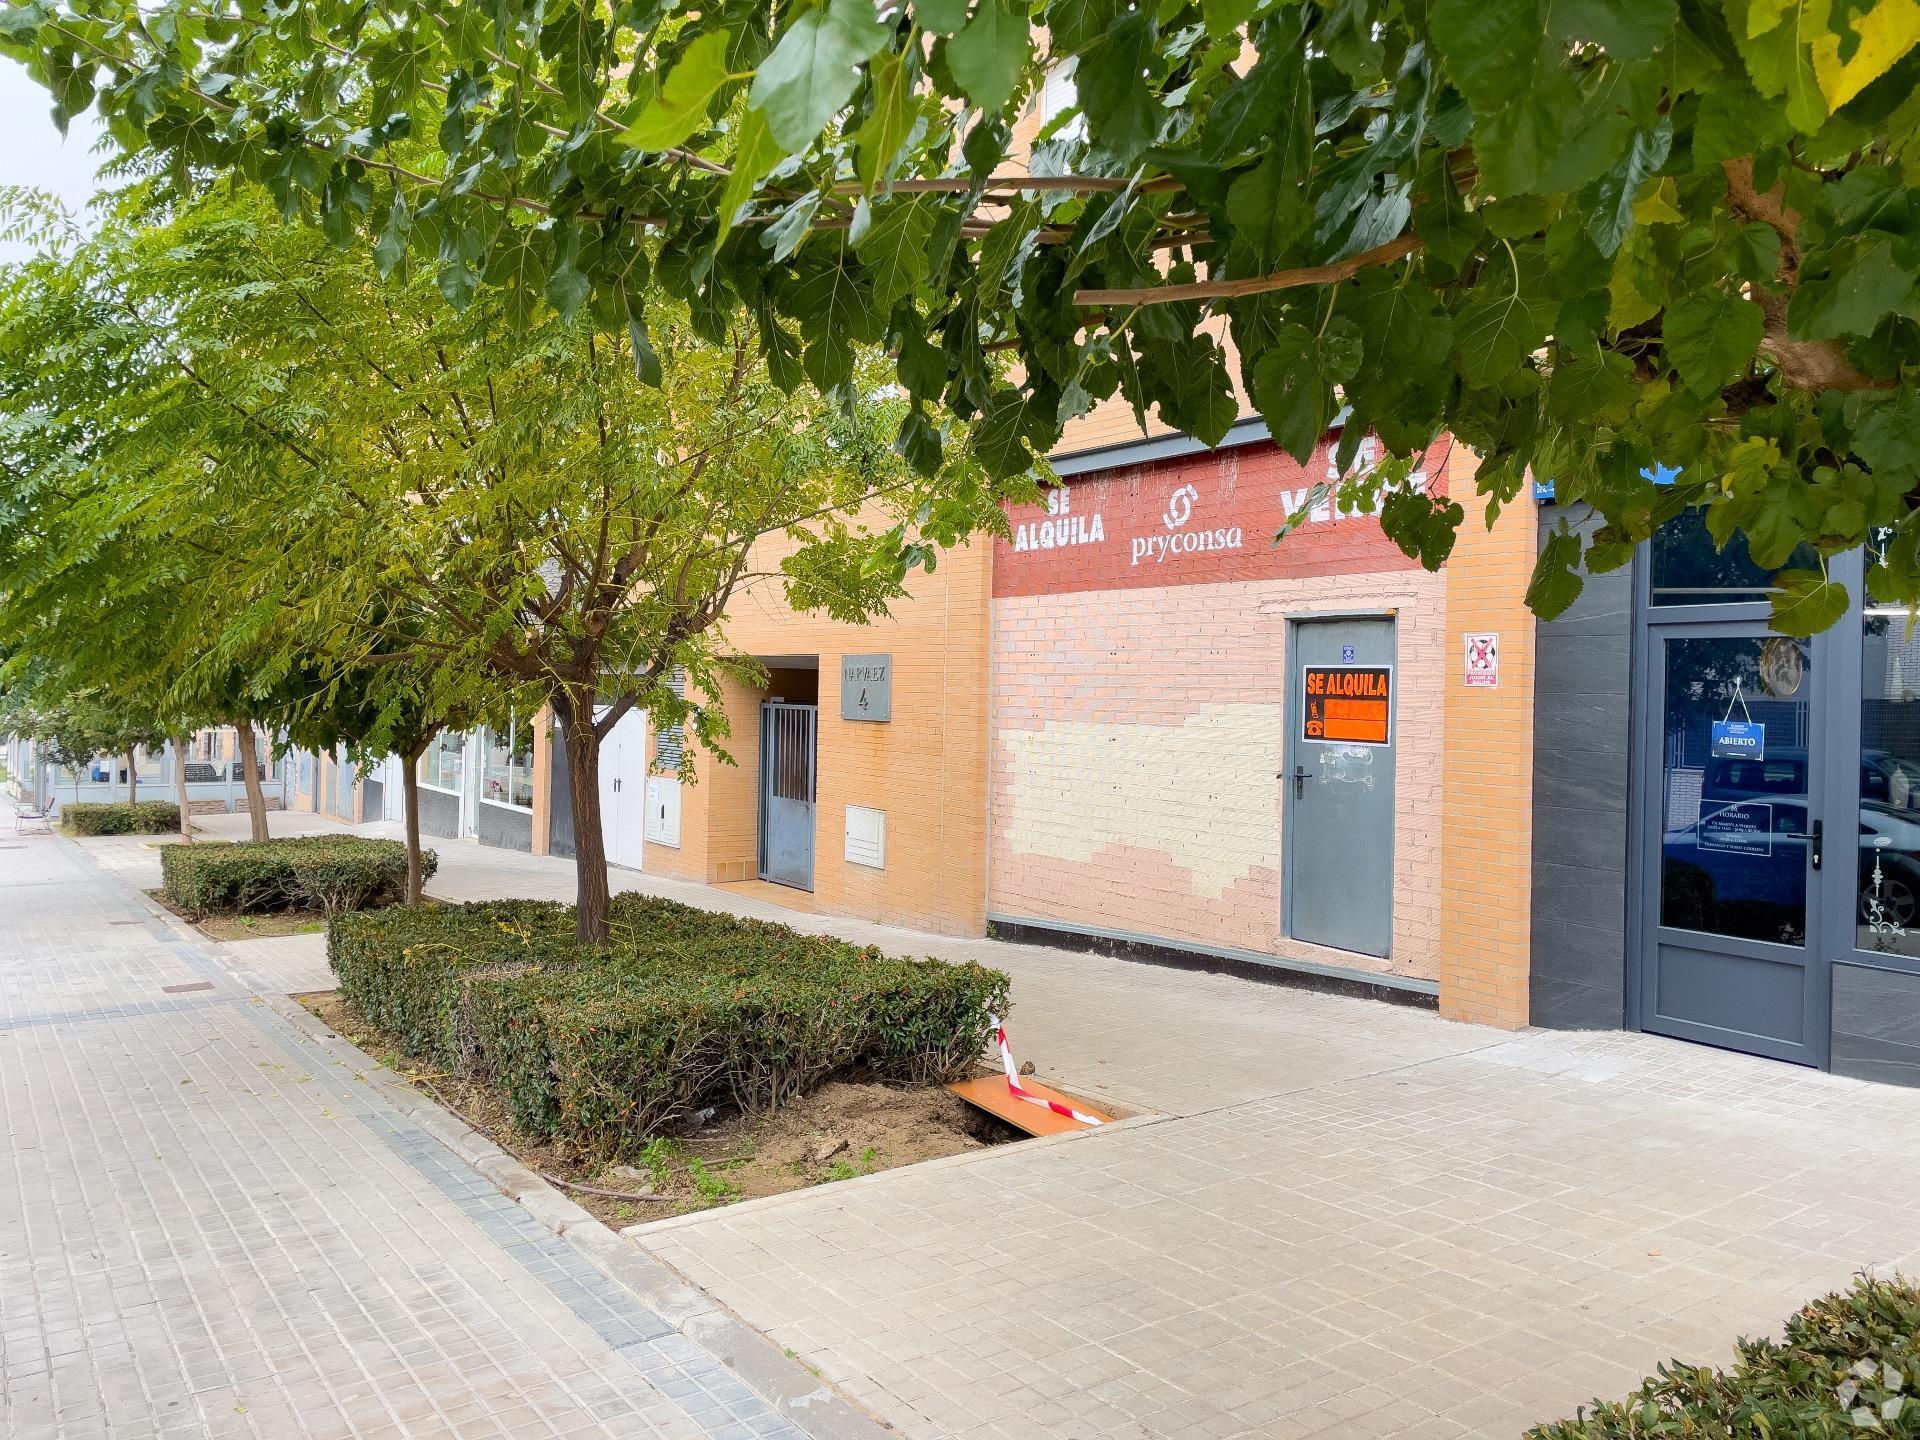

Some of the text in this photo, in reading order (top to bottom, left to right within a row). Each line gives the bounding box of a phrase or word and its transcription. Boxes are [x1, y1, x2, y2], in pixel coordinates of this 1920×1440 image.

[1047, 487, 1071, 517] SE
[1015, 514, 1105, 553] ALQUILA
[1131, 528, 1243, 566] pryconsa
[1307, 672, 1388, 697] SE ALQUILA
[858, 687, 869, 711] 4
[1718, 736, 1756, 747] ABIERTO
[1719, 811, 1750, 820] HORARIO
